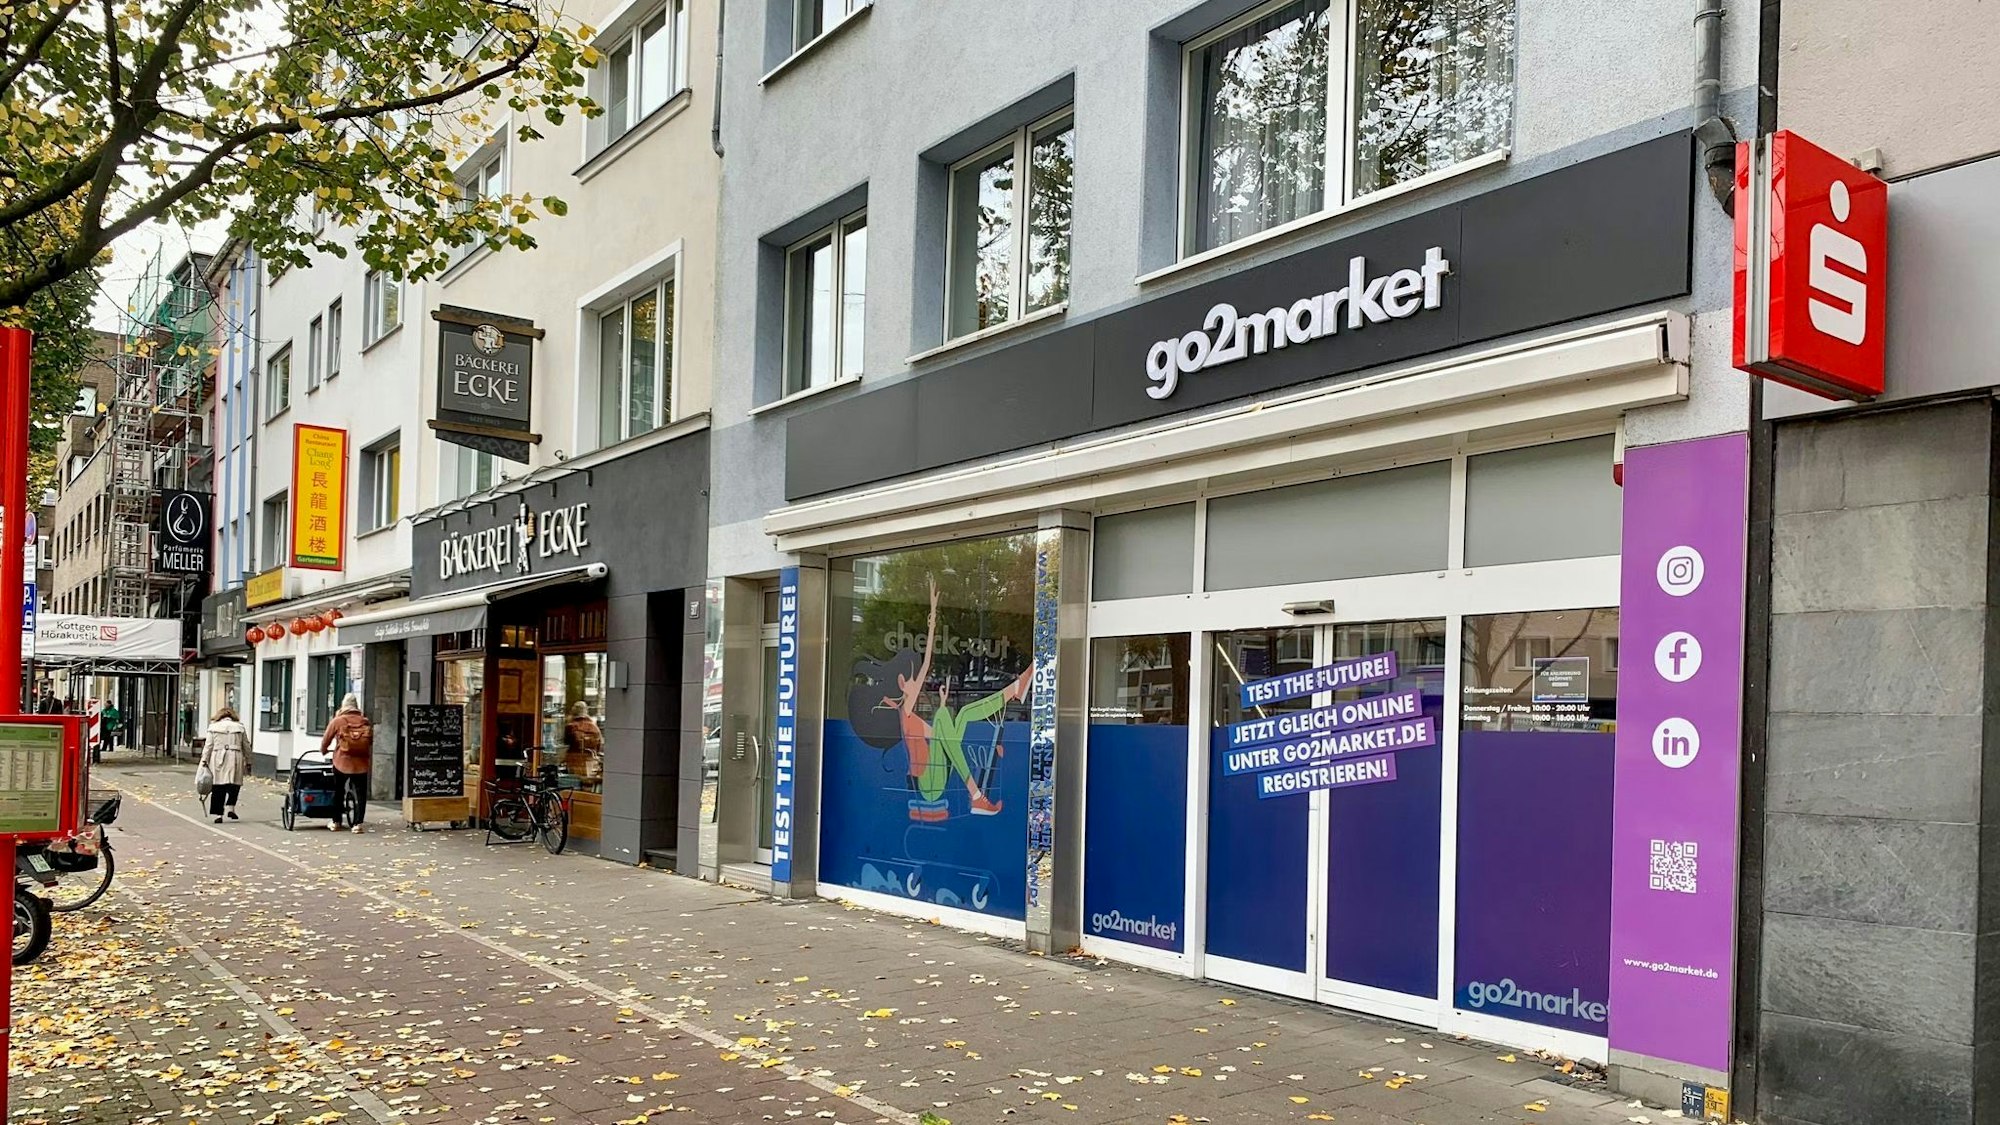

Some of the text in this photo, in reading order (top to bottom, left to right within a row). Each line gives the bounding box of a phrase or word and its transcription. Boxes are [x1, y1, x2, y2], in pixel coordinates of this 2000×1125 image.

[1145, 246, 1450, 400] go2market
[455, 353, 520, 376] BÄCKEREI
[453, 370, 519, 405] ECKE
[306, 448, 334, 461] Chang
[310, 457, 332, 470] Long
[163, 544, 204, 554] Parfümerie
[439, 503, 588, 580] BÄCKEREI ECKE
[162, 552, 204, 571] MELLER
[41, 630, 98, 641] Hörakustik
[883, 621, 1010, 659] check-out
[1247, 656, 1390, 702] TEST THE FUTURE!
[1463, 685, 1513, 695] Öffnungszeiten:
[773, 585, 796, 863] TEST THE FUTURE!
[1233, 694, 1415, 744] JETZT GLEICH ONLINE
[1463, 704, 1501, 713] Donnerstag
[1507, 704, 1531, 713] Freitag
[1576, 704, 1591, 712] Uhr
[1463, 714, 1491, 723] Samstag
[1531, 714, 1551, 722] 10:00
[1556, 714, 1575, 722] 18:00
[1576, 714, 1590, 722] Uhr
[1229, 723, 1427, 772] UNTER GO2MARKET.DE
[1263, 759, 1388, 794] REGISTRIEREN!
[1092, 909, 1177, 941] go2market
[1623, 957, 1719, 980] www.go2market.de
[1468, 978, 1610, 1023] go2marke
